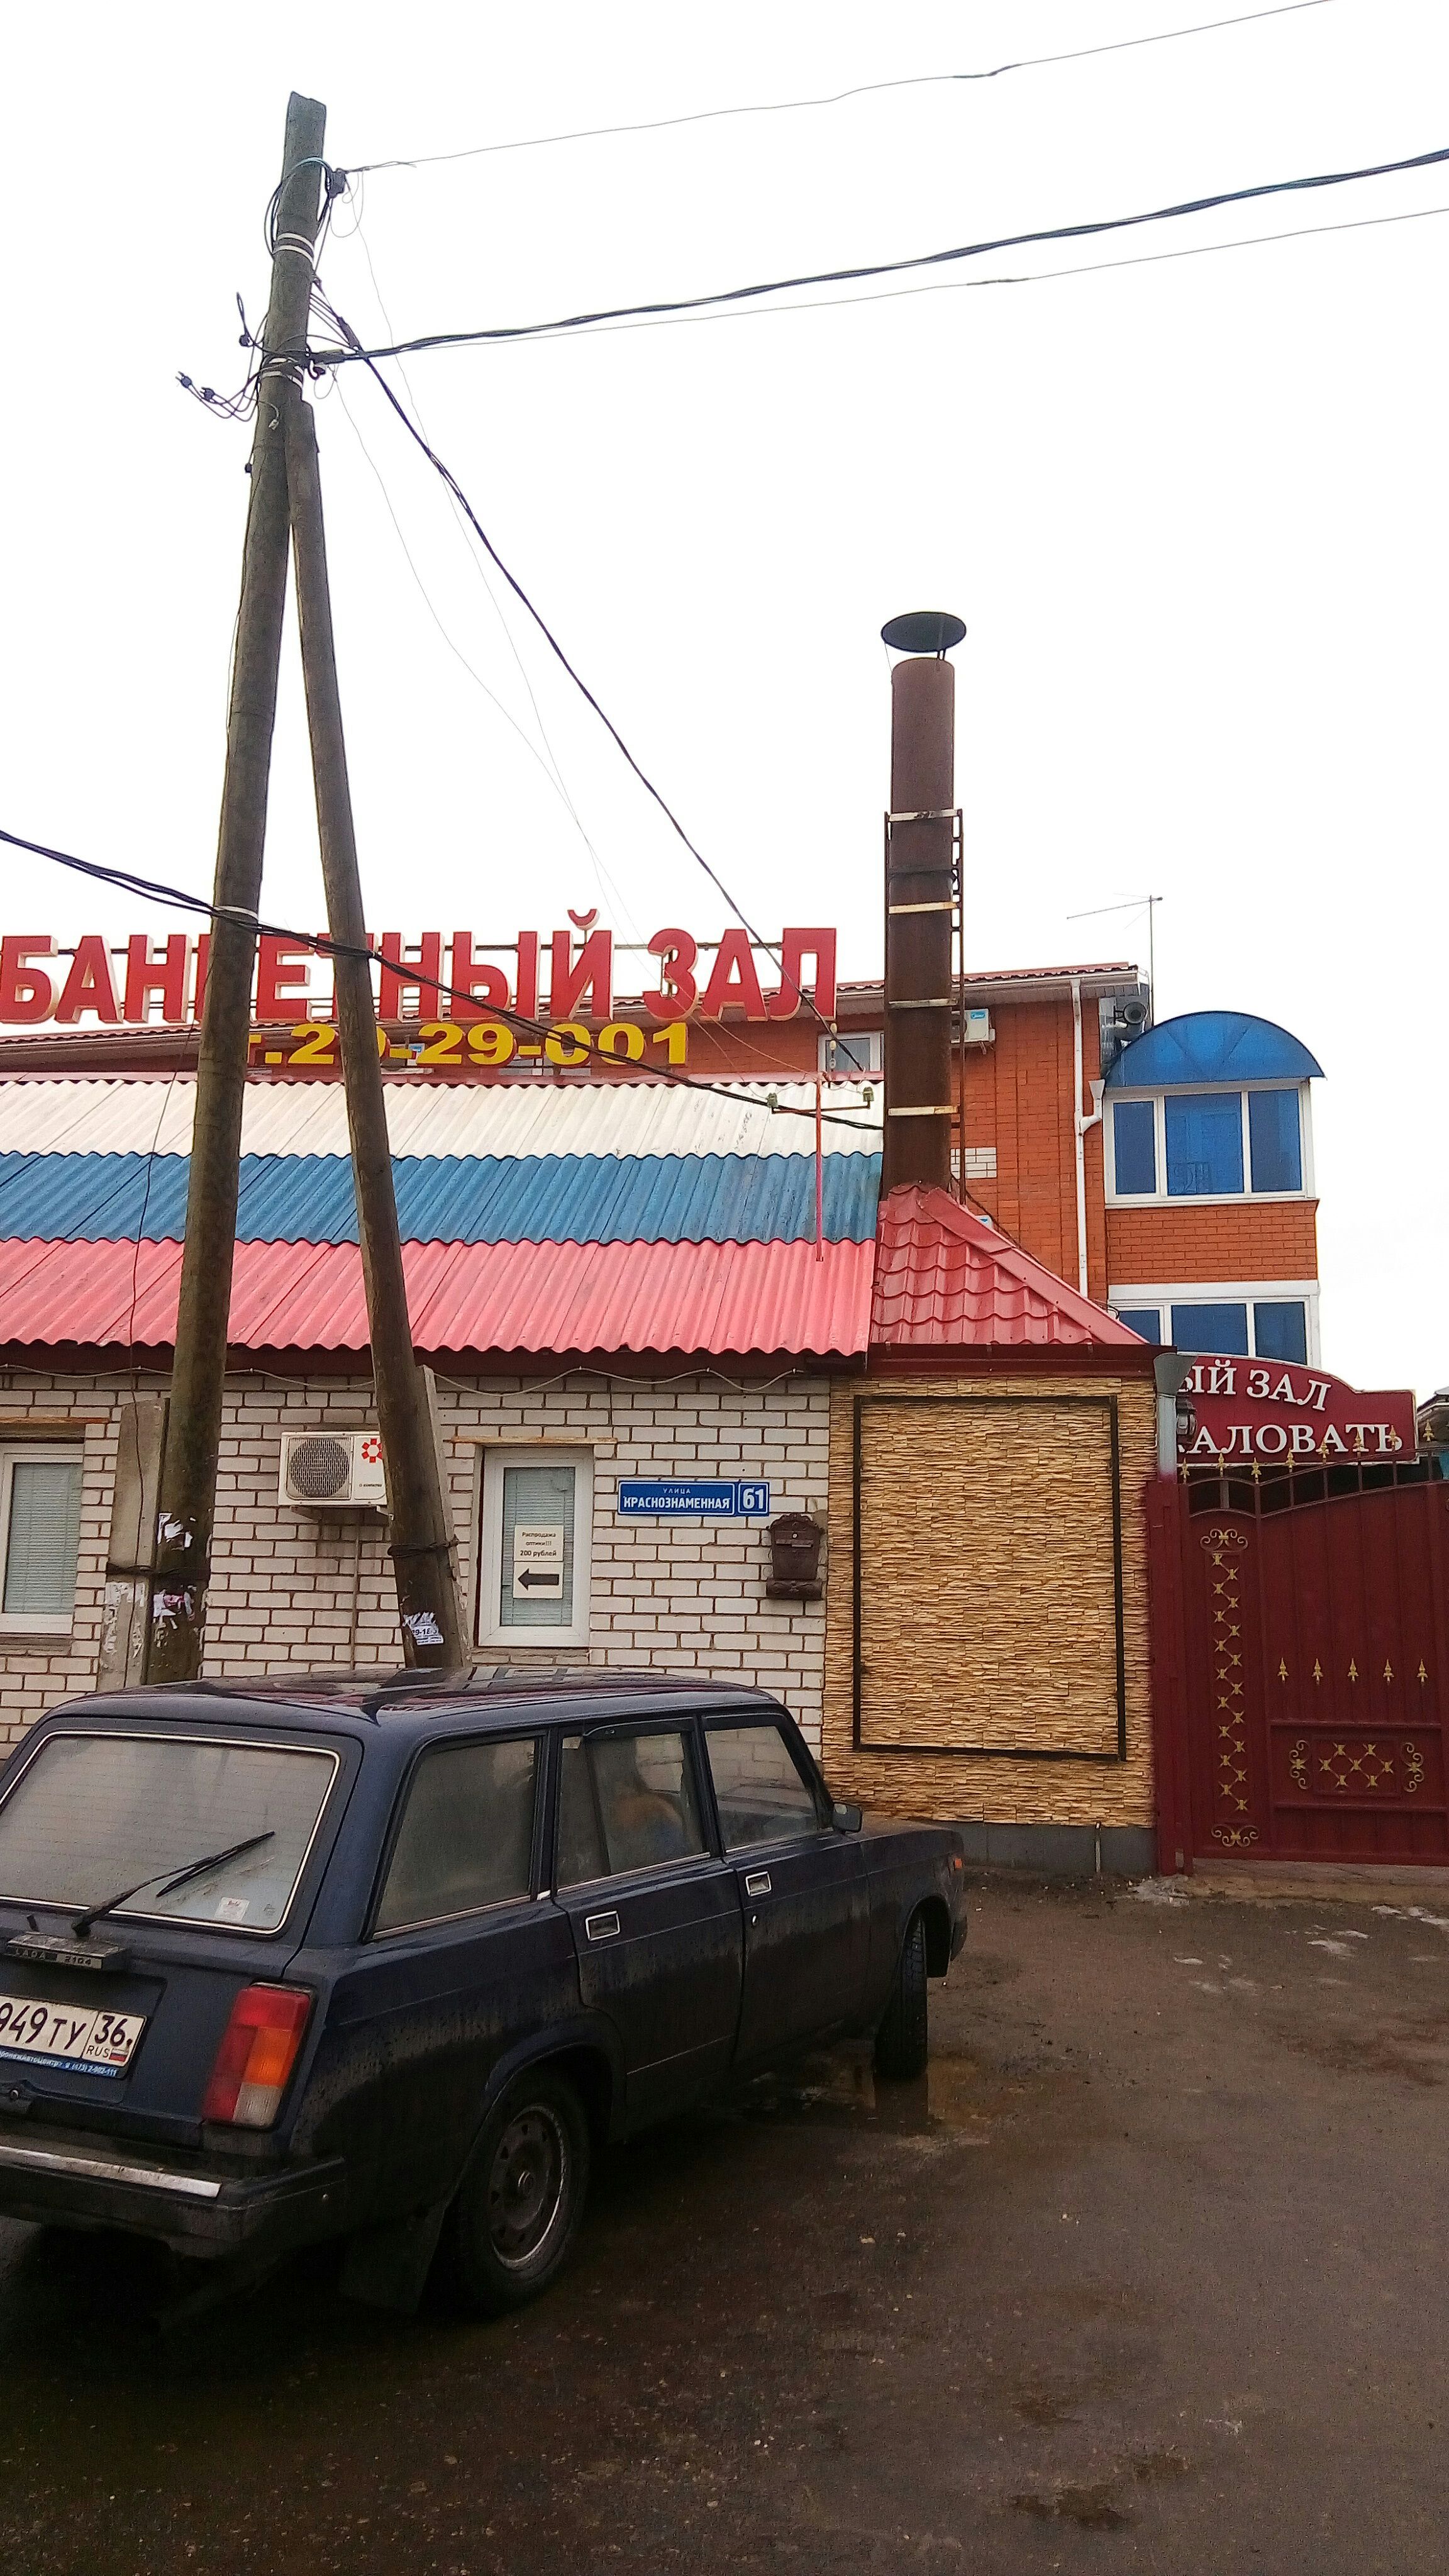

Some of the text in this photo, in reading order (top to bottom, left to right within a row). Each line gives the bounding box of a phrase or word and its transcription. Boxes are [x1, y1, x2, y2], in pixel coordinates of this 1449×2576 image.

[1, 909, 837, 1024] БАНЕНЫЙ ЗАЛ
[1246, 1368, 1331, 1411] ЗАЛ
[1178, 1424, 1403, 1454] АЛОВАТЬ
[623, 1496, 731, 1509] КРАСНОЗНАМЕННАЯ
[742, 1487, 764, 1509] 61
[533, 1549, 557, 1557] рублей
[16, 1948, 92, 1966] LADA 2104
[94, 2014, 128, 2047] 36
[86, 2045, 110, 2058] RUS
